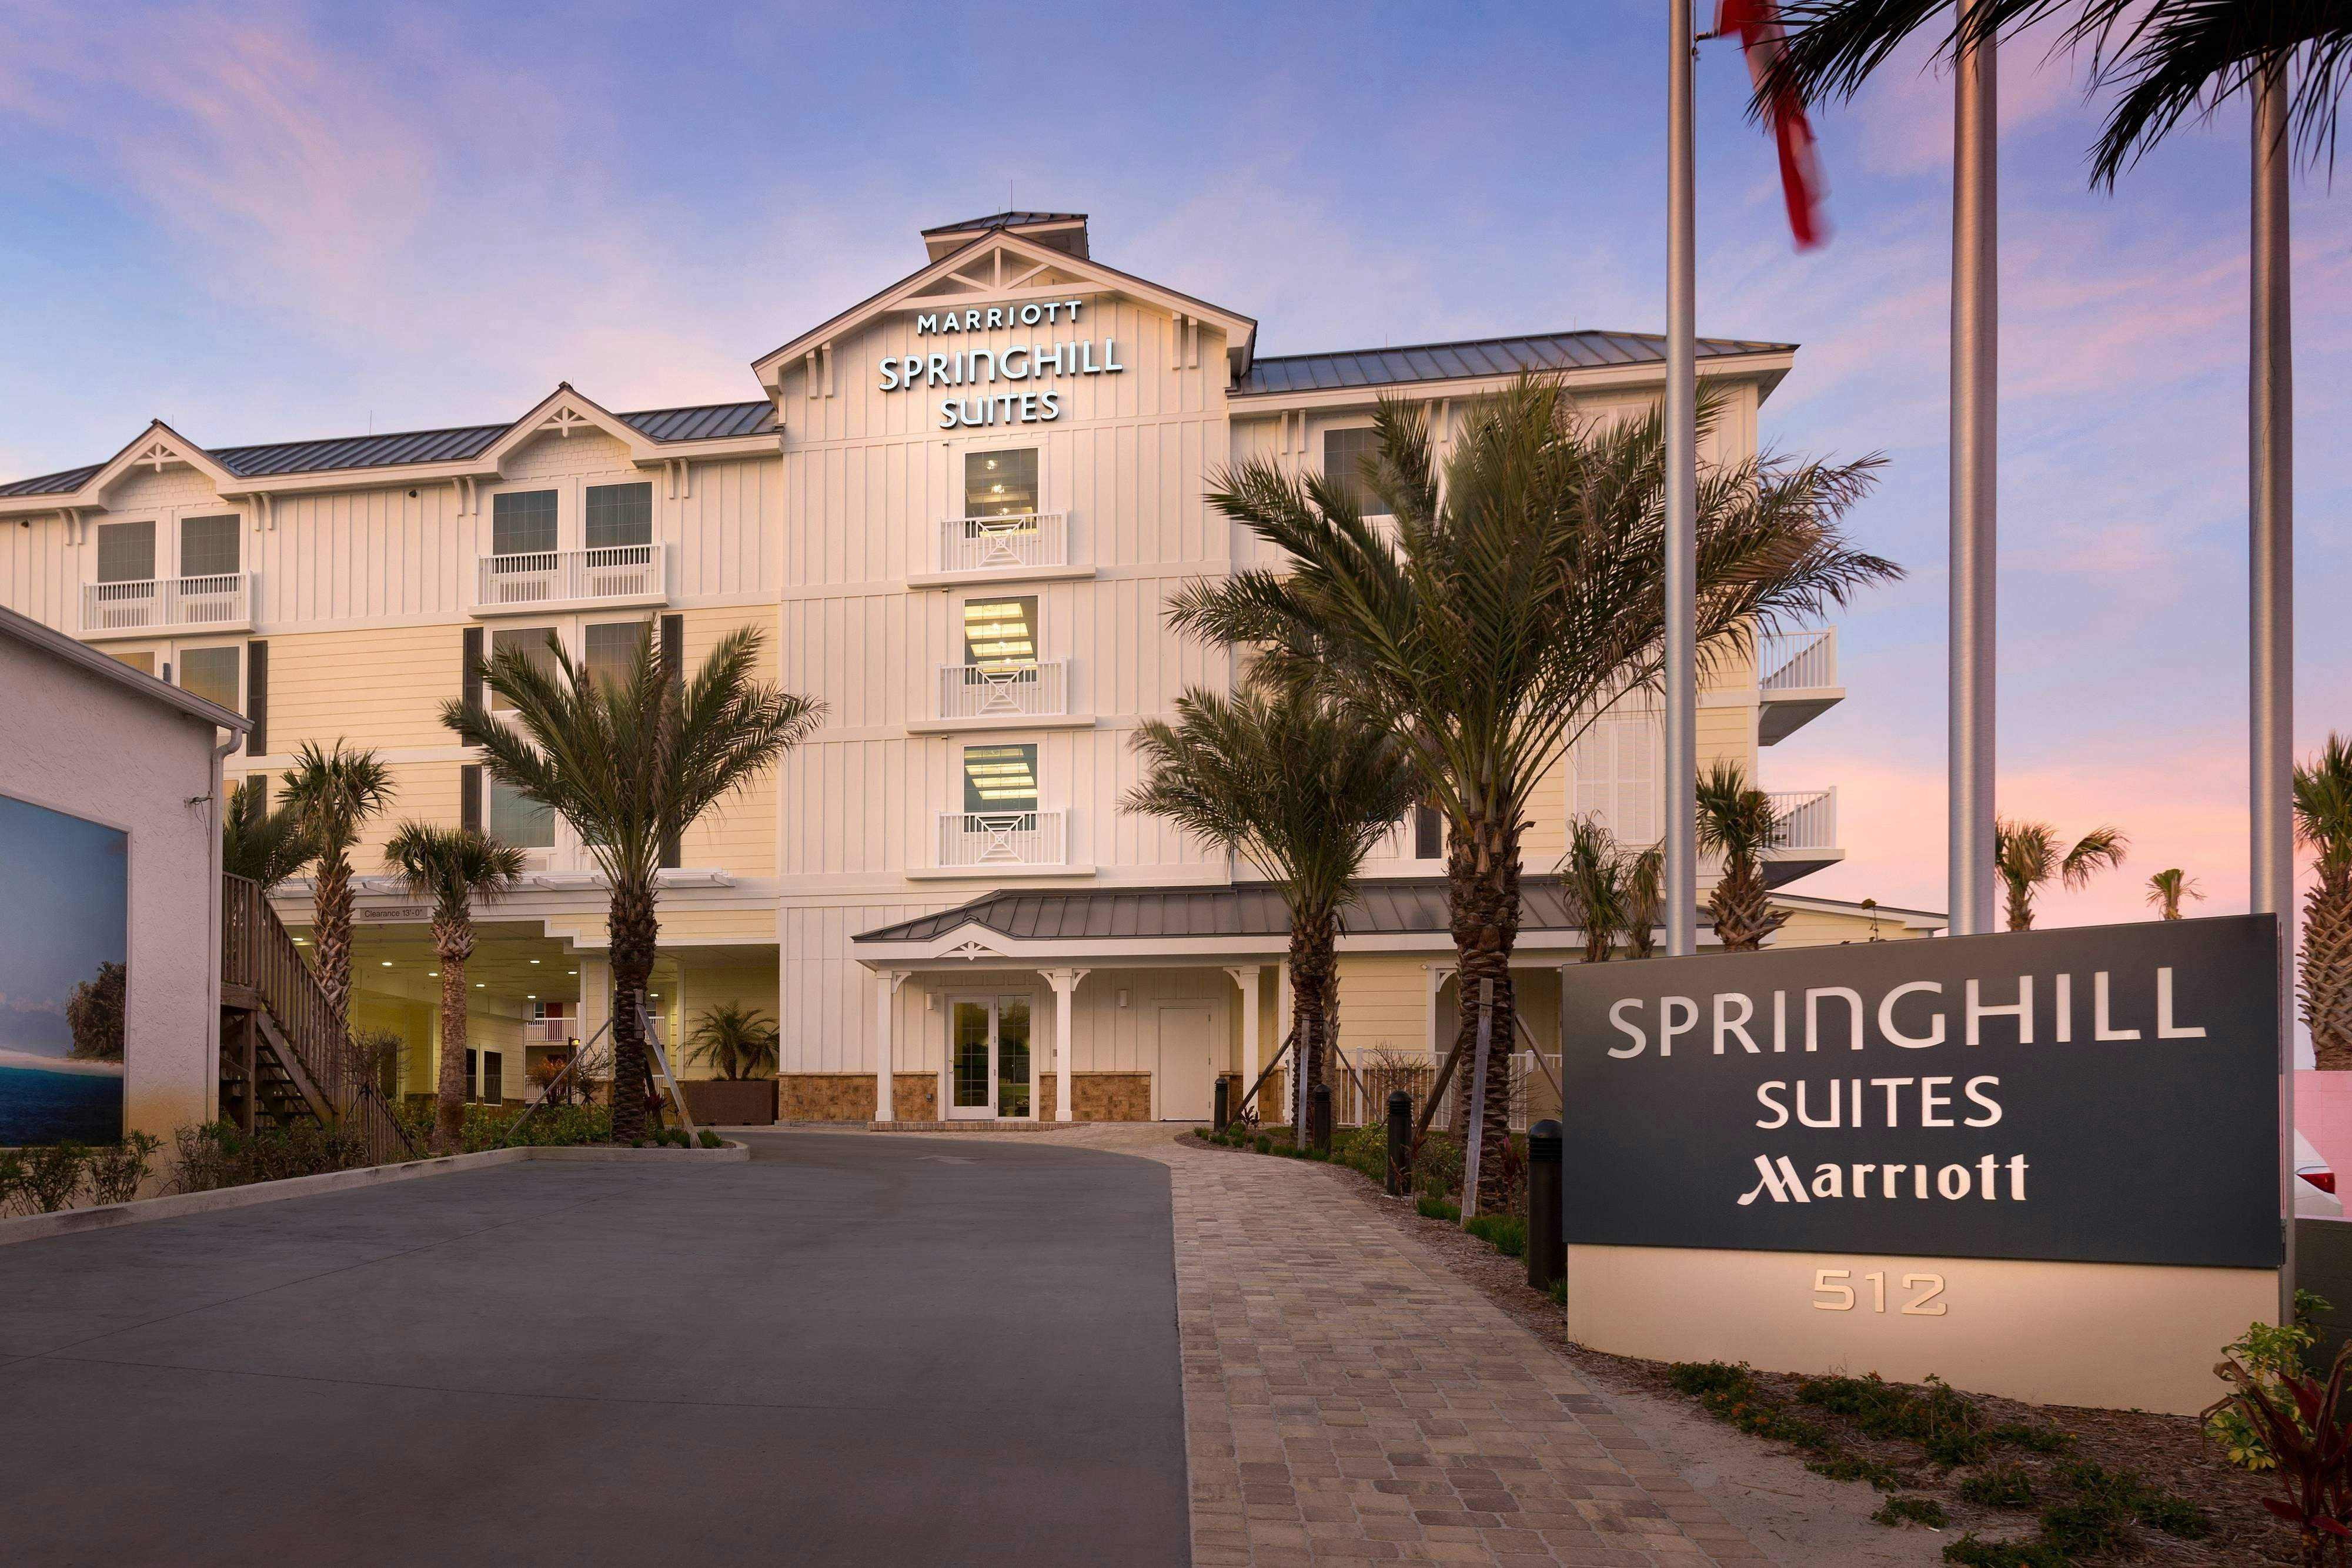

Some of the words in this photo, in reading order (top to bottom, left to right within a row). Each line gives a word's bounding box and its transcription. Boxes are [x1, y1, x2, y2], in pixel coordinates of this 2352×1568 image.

[917, 300, 1082, 336] MARRIOTT
[878, 337, 1123, 392] SPRINGHILL
[940, 390, 1059, 429] SUITES
[402, 908, 422, 917] 13'-0"
[1606, 967, 2207, 1059] SPRINGHILL
[1755, 1075, 2003, 1129] SUITES
[1736, 1154, 2030, 1206] Marriott
[1812, 1269, 1948, 1316] 512
